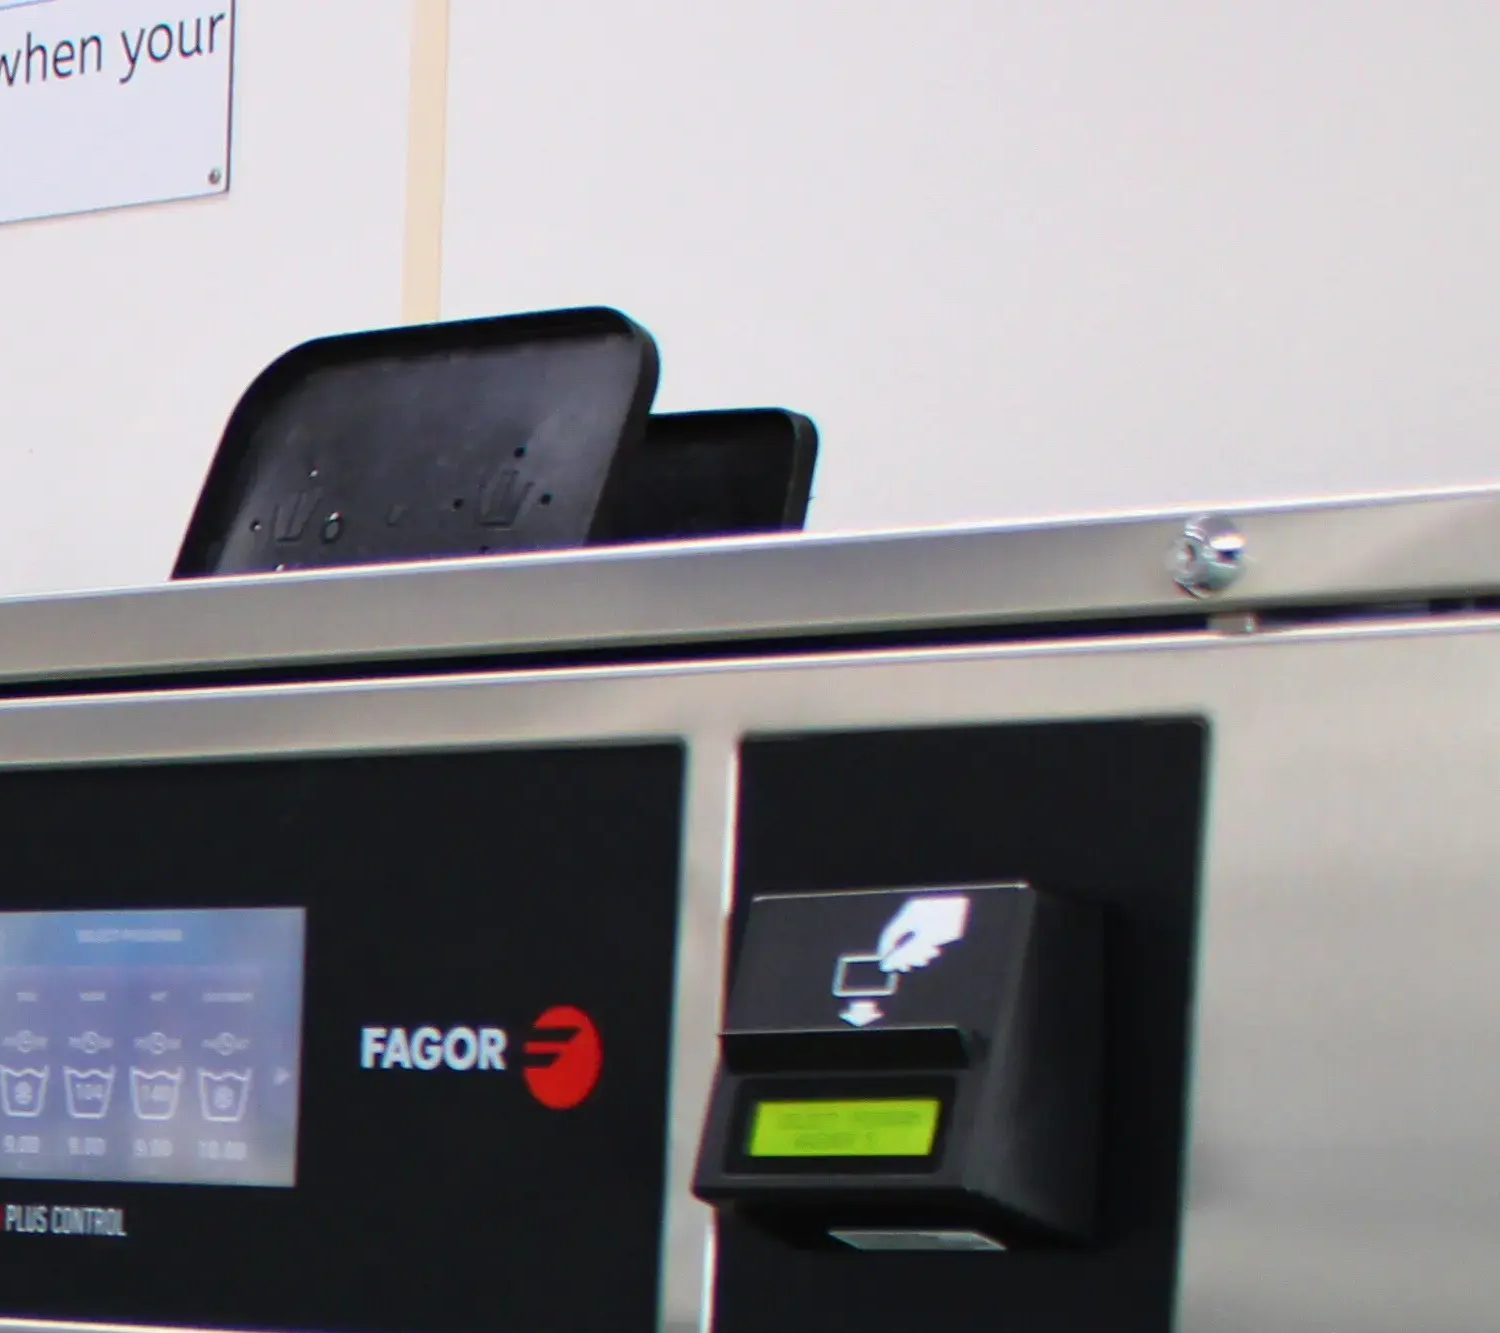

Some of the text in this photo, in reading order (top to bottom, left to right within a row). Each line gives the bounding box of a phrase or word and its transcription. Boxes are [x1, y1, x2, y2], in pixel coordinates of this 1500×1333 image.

[119, 11, 227, 85] your
[359, 1025, 508, 1071] FAGOR
[4, 1203, 48, 1234] PLUS
[49, 1205, 128, 1237] CONTROL
